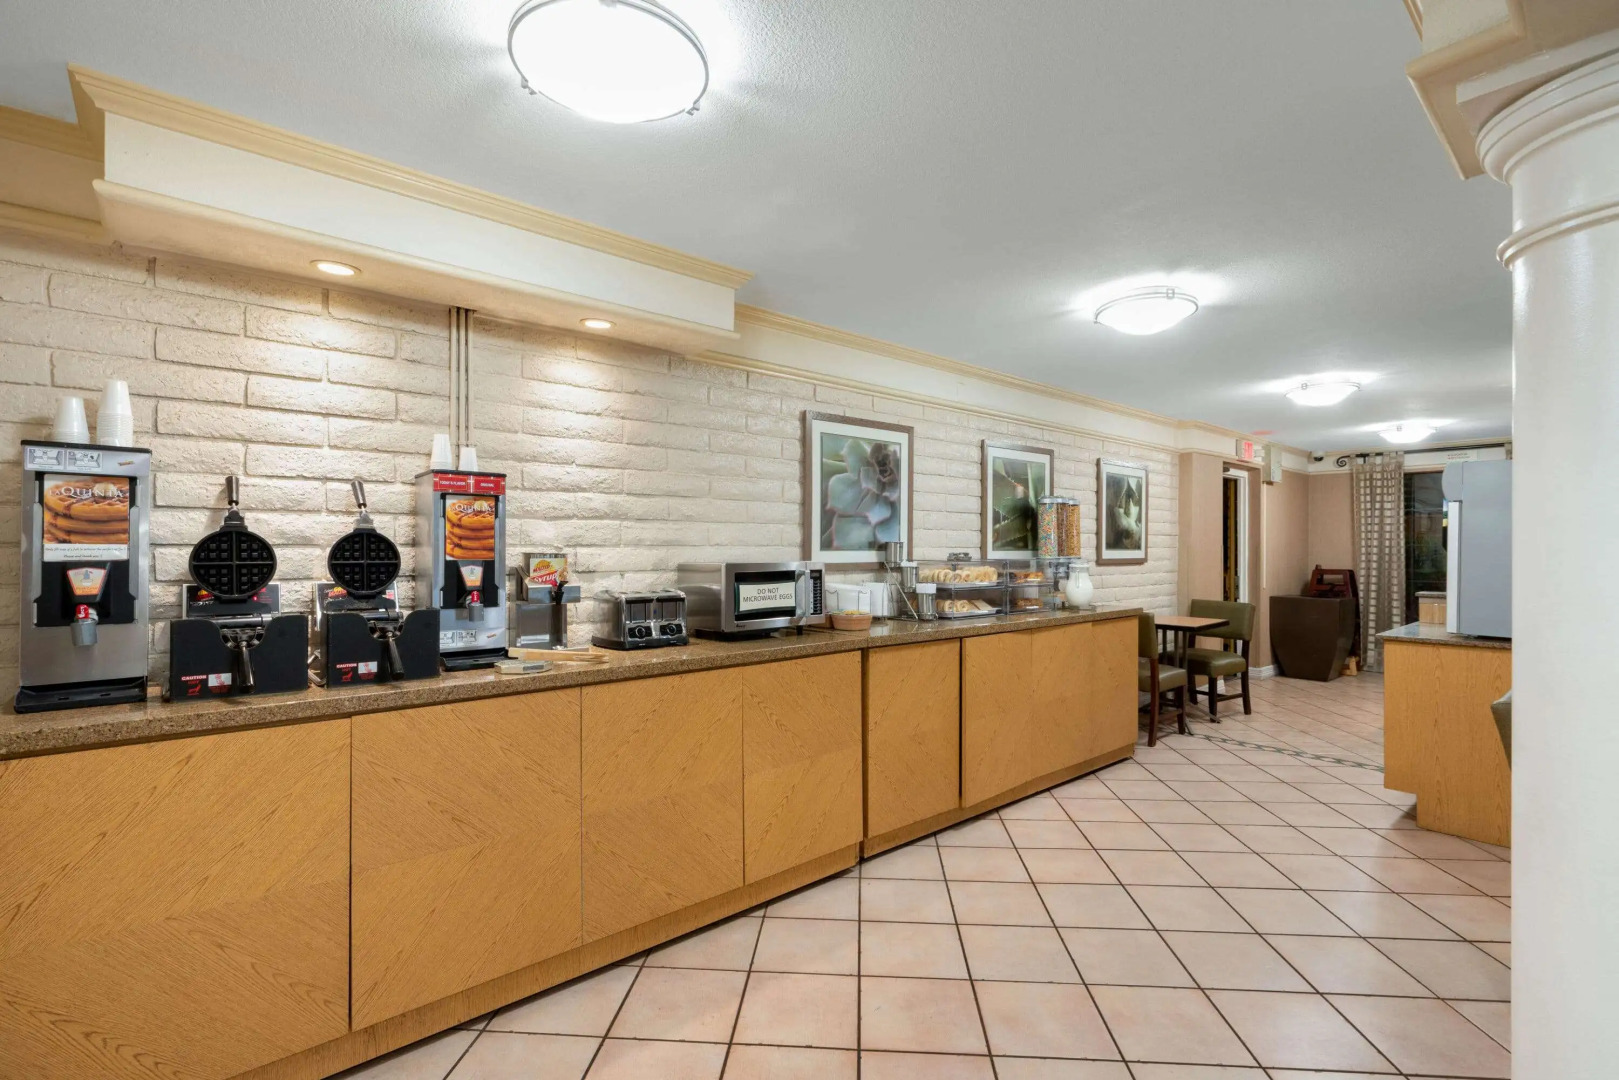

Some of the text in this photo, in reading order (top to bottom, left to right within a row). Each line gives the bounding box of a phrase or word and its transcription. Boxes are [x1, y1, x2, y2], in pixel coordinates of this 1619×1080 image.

[61, 486, 124, 499] QUINTA
[534, 572, 558, 583] Syrup
[742, 594, 777, 602] MICROWAVE
